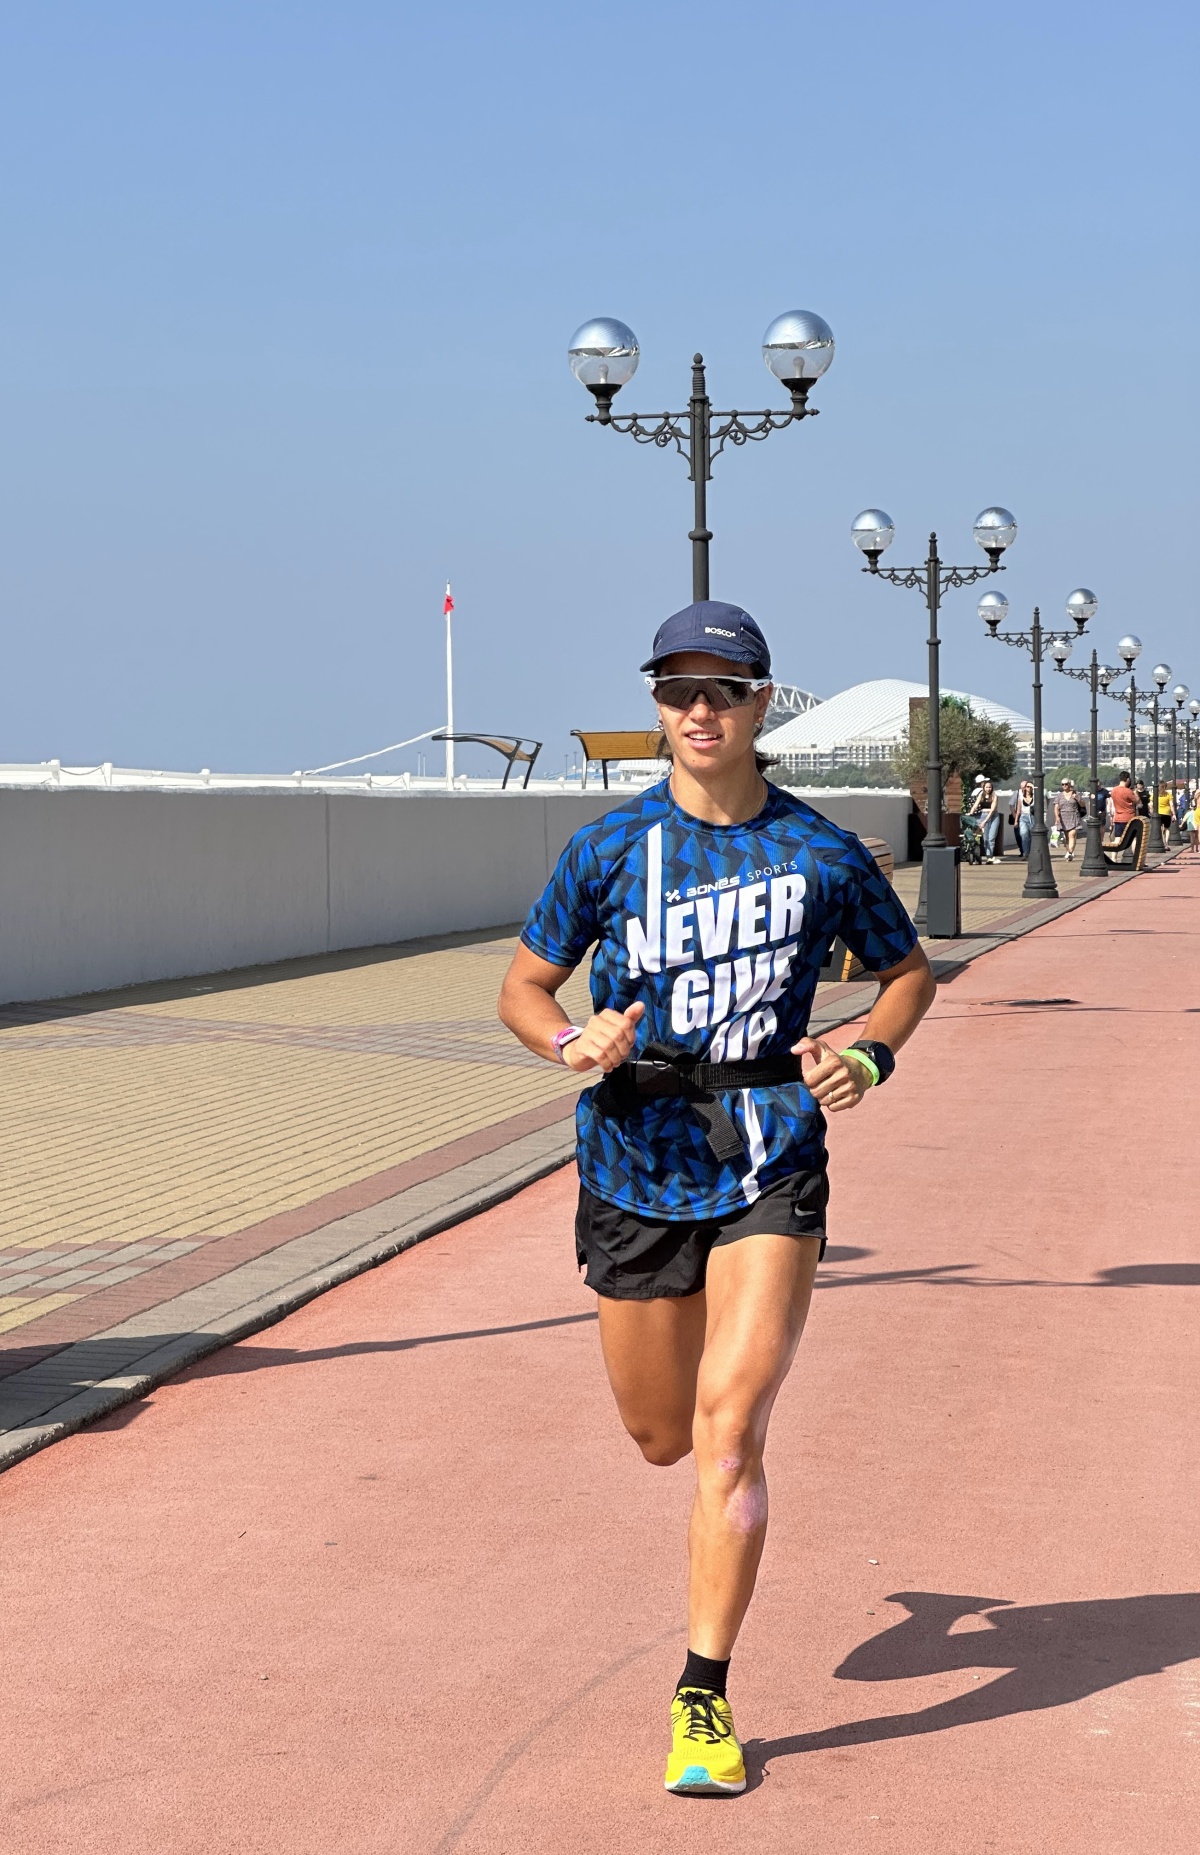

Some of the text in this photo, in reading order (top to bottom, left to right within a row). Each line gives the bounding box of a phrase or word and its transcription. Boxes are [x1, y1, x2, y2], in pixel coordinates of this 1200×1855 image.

[705, 627, 732, 637] BOSCO
[747, 860, 798, 881] SPORTS
[626, 822, 806, 979] NEVER
[671, 943, 797, 1035] GIVE
